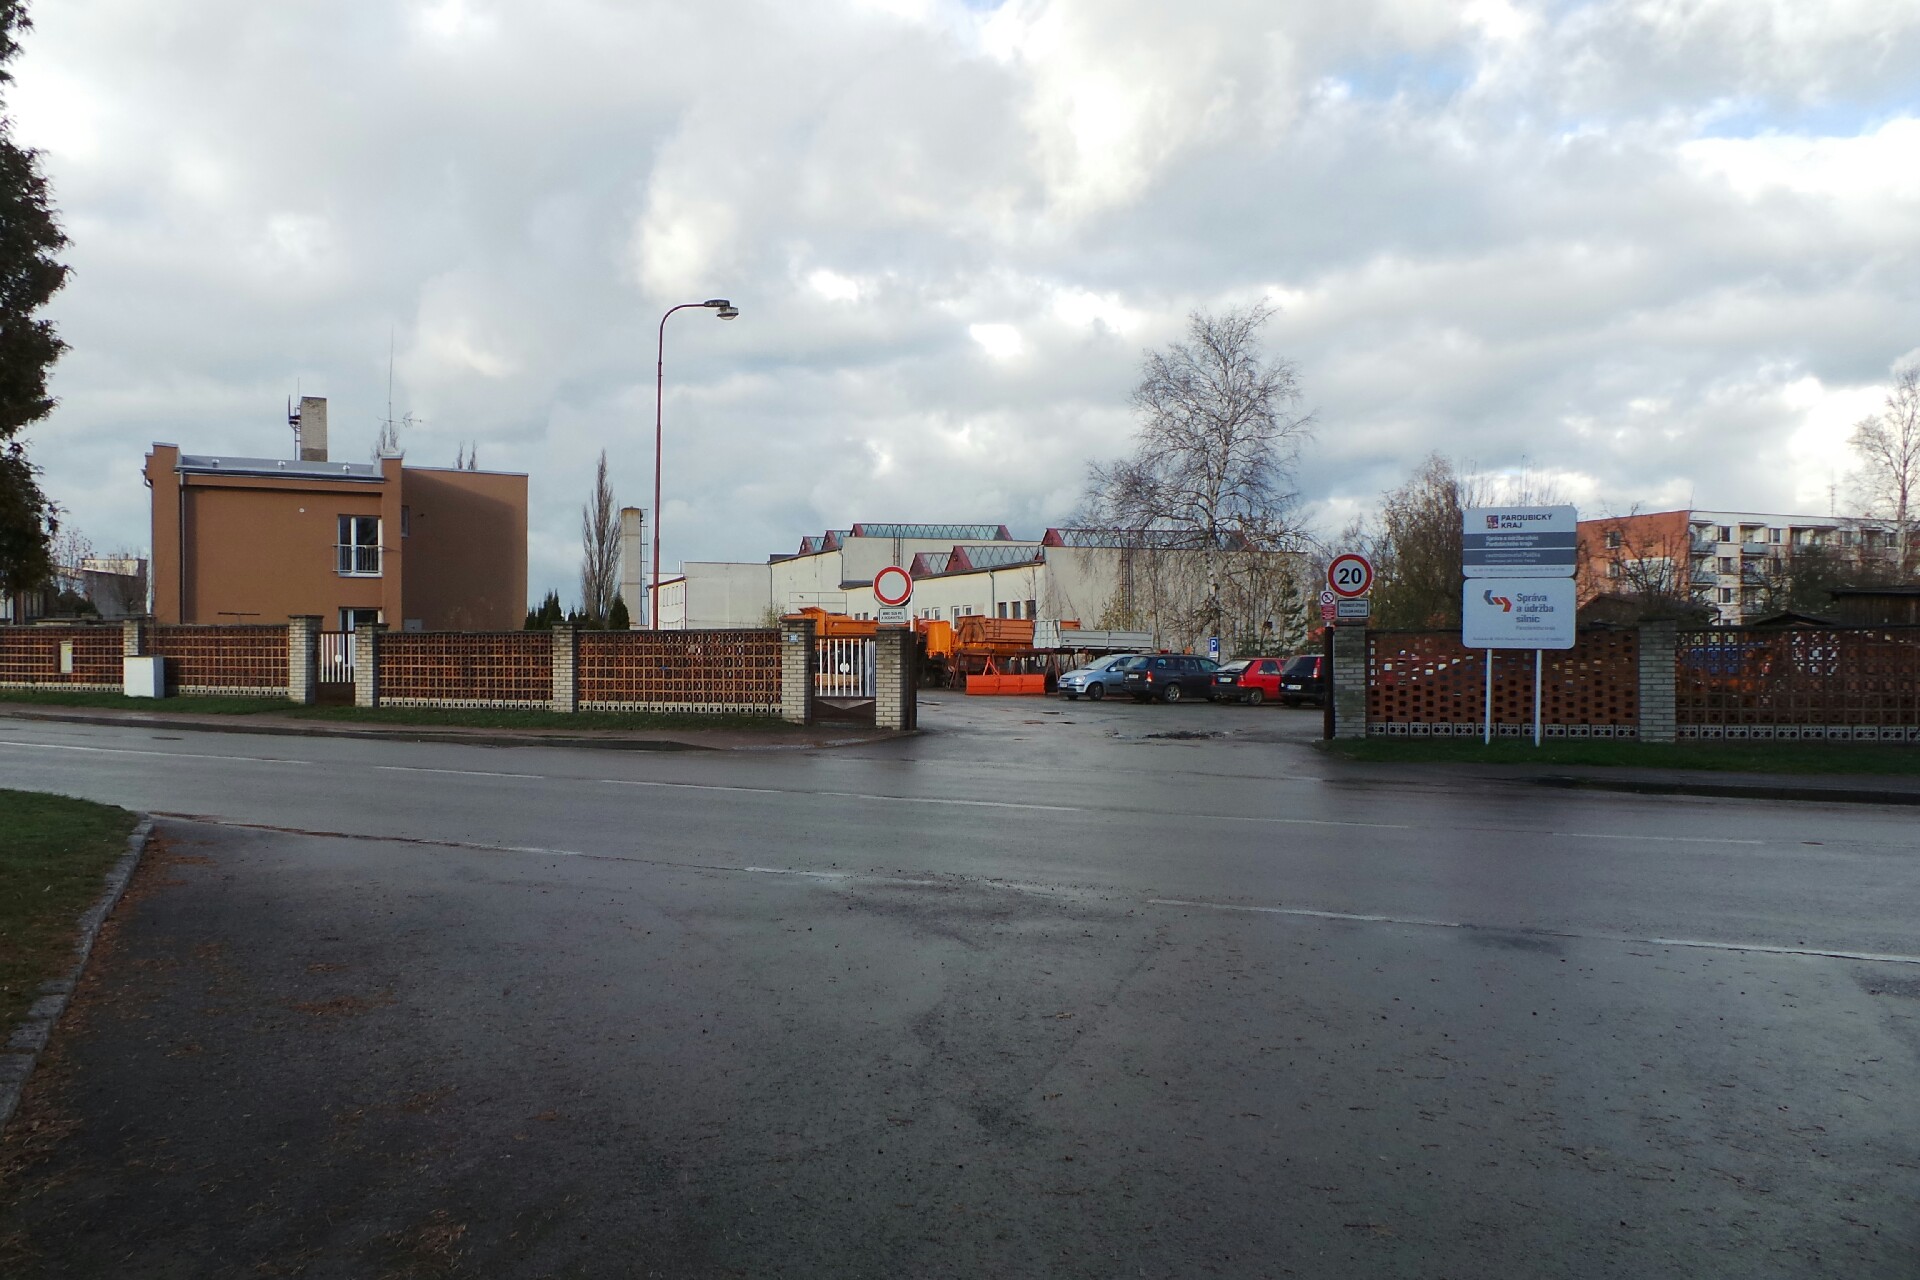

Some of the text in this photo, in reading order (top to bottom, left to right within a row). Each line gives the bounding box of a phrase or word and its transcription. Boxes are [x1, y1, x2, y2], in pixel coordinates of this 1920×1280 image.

[1501, 513, 1552, 521] PARDUBICKÝ
[1338, 568, 1362, 584] 20
[1516, 593, 1547, 603] Správa
[1524, 604, 1554, 613] údržba
[1516, 614, 1540, 623] silnic
